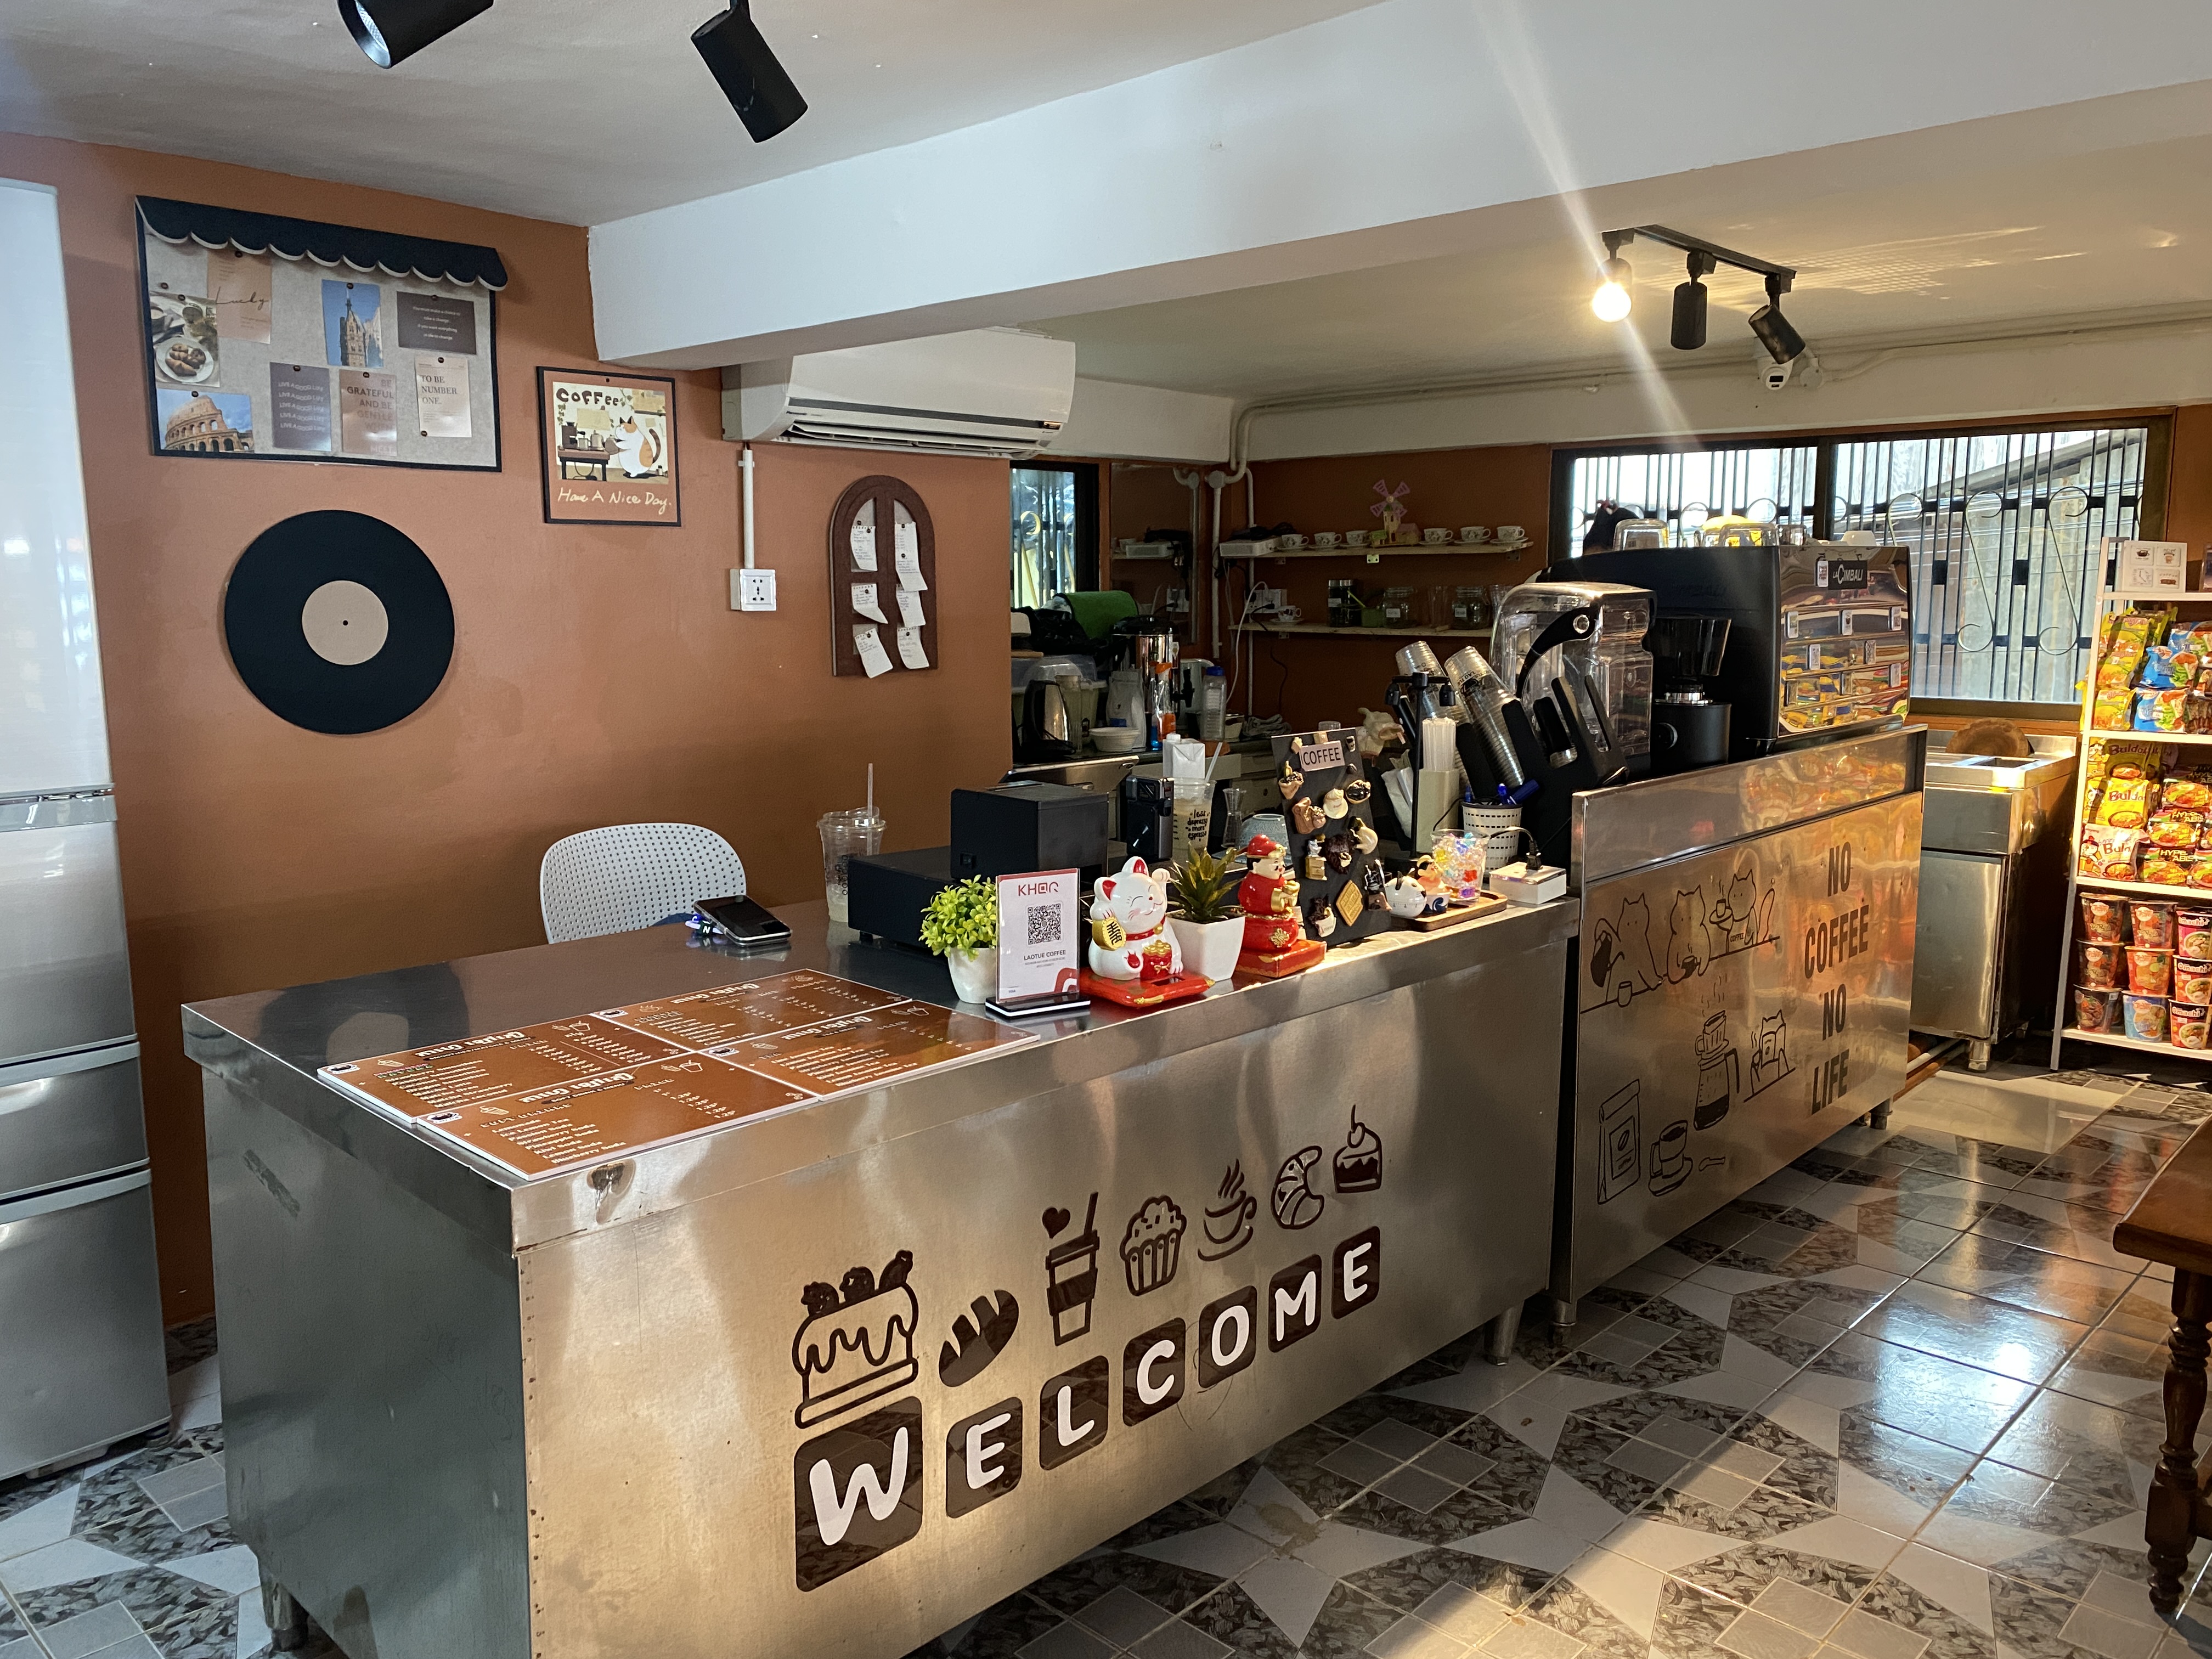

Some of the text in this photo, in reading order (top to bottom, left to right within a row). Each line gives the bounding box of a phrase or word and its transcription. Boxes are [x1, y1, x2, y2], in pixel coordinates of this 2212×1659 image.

[347, 386, 394, 399] GRATEFUL
[421, 386, 458, 394] NUMBER
[359, 399, 379, 408] AND
[558, 487, 588, 503] Have
[591, 490, 603, 503] A
[609, 491, 641, 504] Nice
[1303, 747, 1341, 765] COFFEE
[2109, 790, 2145, 801] Bulda
[1827, 842, 1851, 898] NO
[1804, 904, 1869, 980] COFFEE
[1024, 952, 1045, 961] LAOTUE
[1823, 983, 1847, 1040] NO
[1812, 1048, 1849, 1115] LIFE
[809, 1242, 1372, 1546] WELCOME
